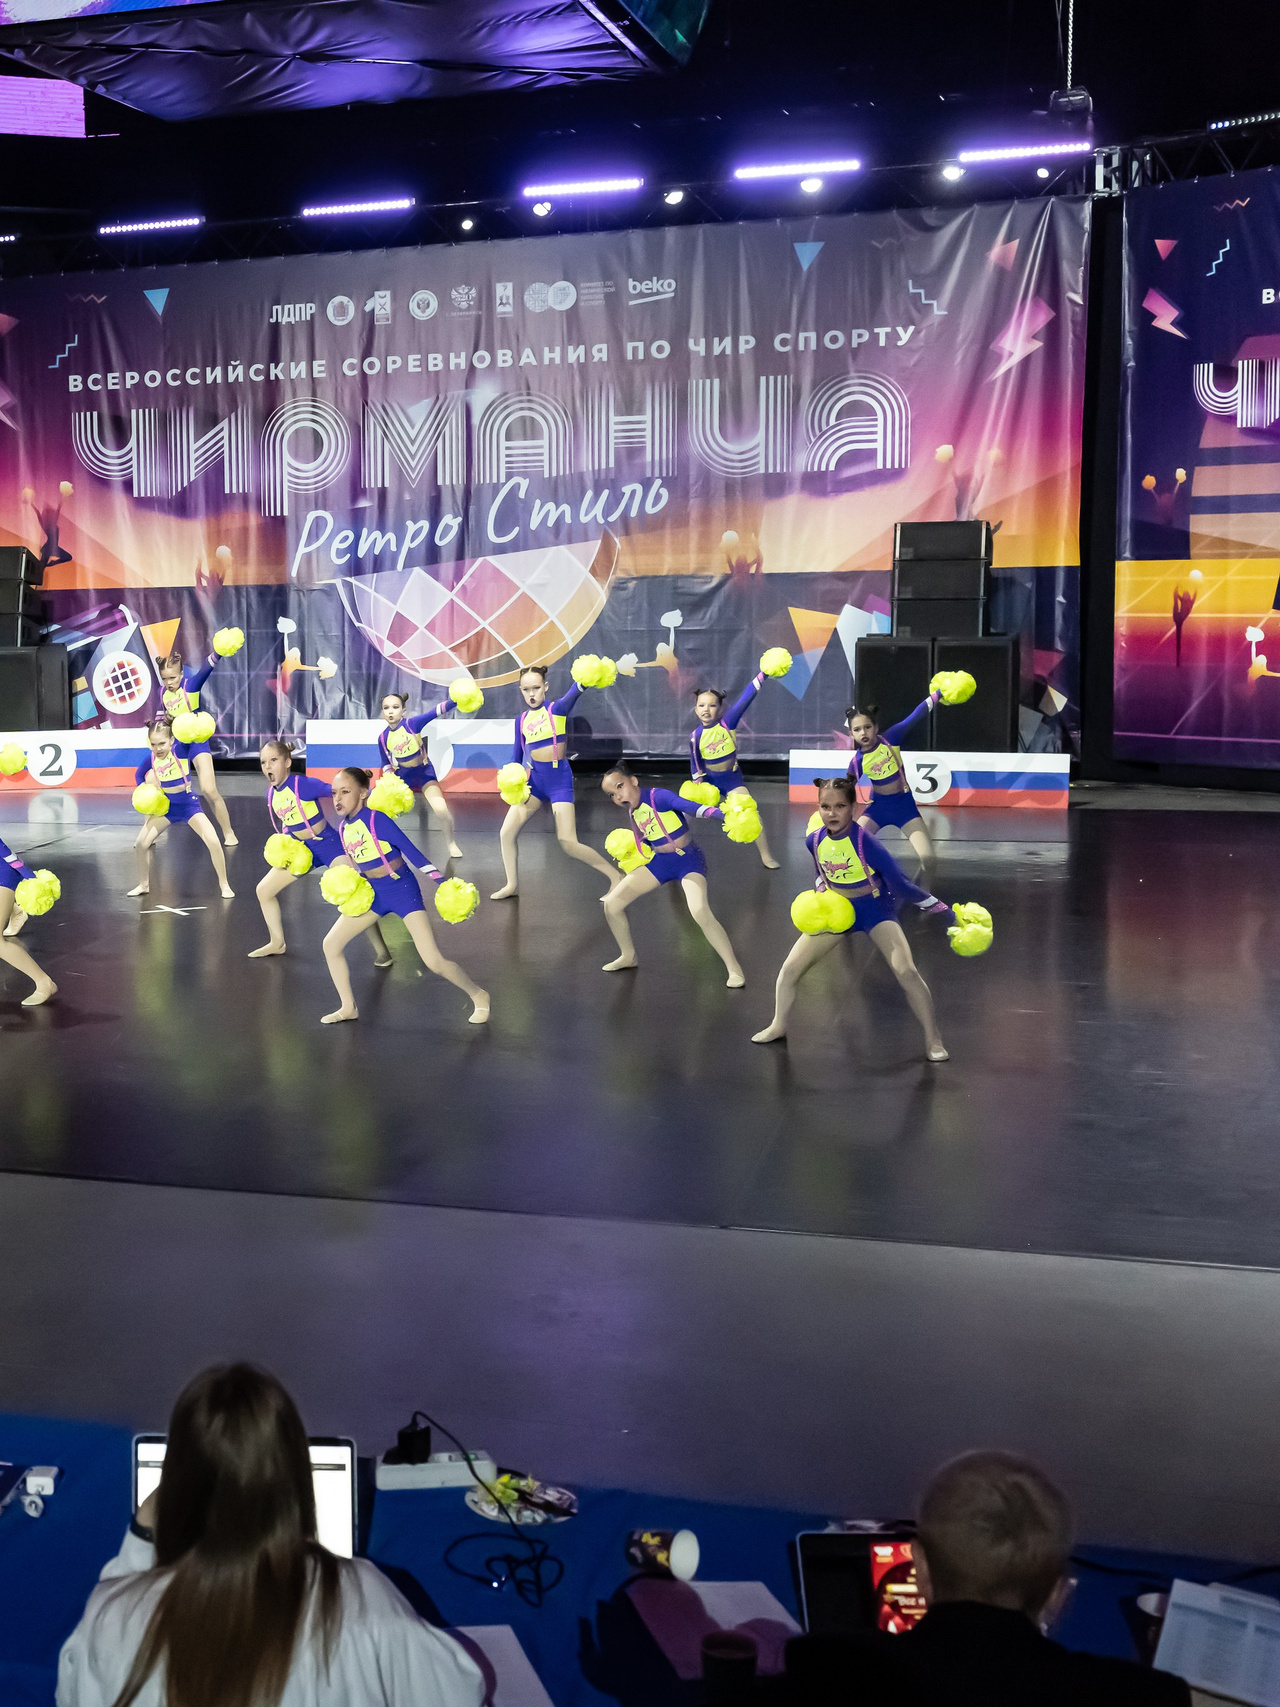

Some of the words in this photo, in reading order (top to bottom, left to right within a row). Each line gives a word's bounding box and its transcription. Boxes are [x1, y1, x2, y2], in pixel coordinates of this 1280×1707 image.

[628, 276, 677, 294] beko
[269, 303, 316, 325] ЛДПР
[68, 359, 326, 392] ВСЕРОССИЙСКИЕ
[342, 343, 608, 376] СОРЕВНОВАНИЯ
[627, 340, 671, 360] ПО
[688, 335, 756, 356] ЧИР
[773, 325, 916, 353] СПОРТУ
[290, 509, 462, 578] Ретро
[486, 476, 669, 544] Стиль
[39, 743, 63, 776] 2
[914, 763, 938, 794] 3
